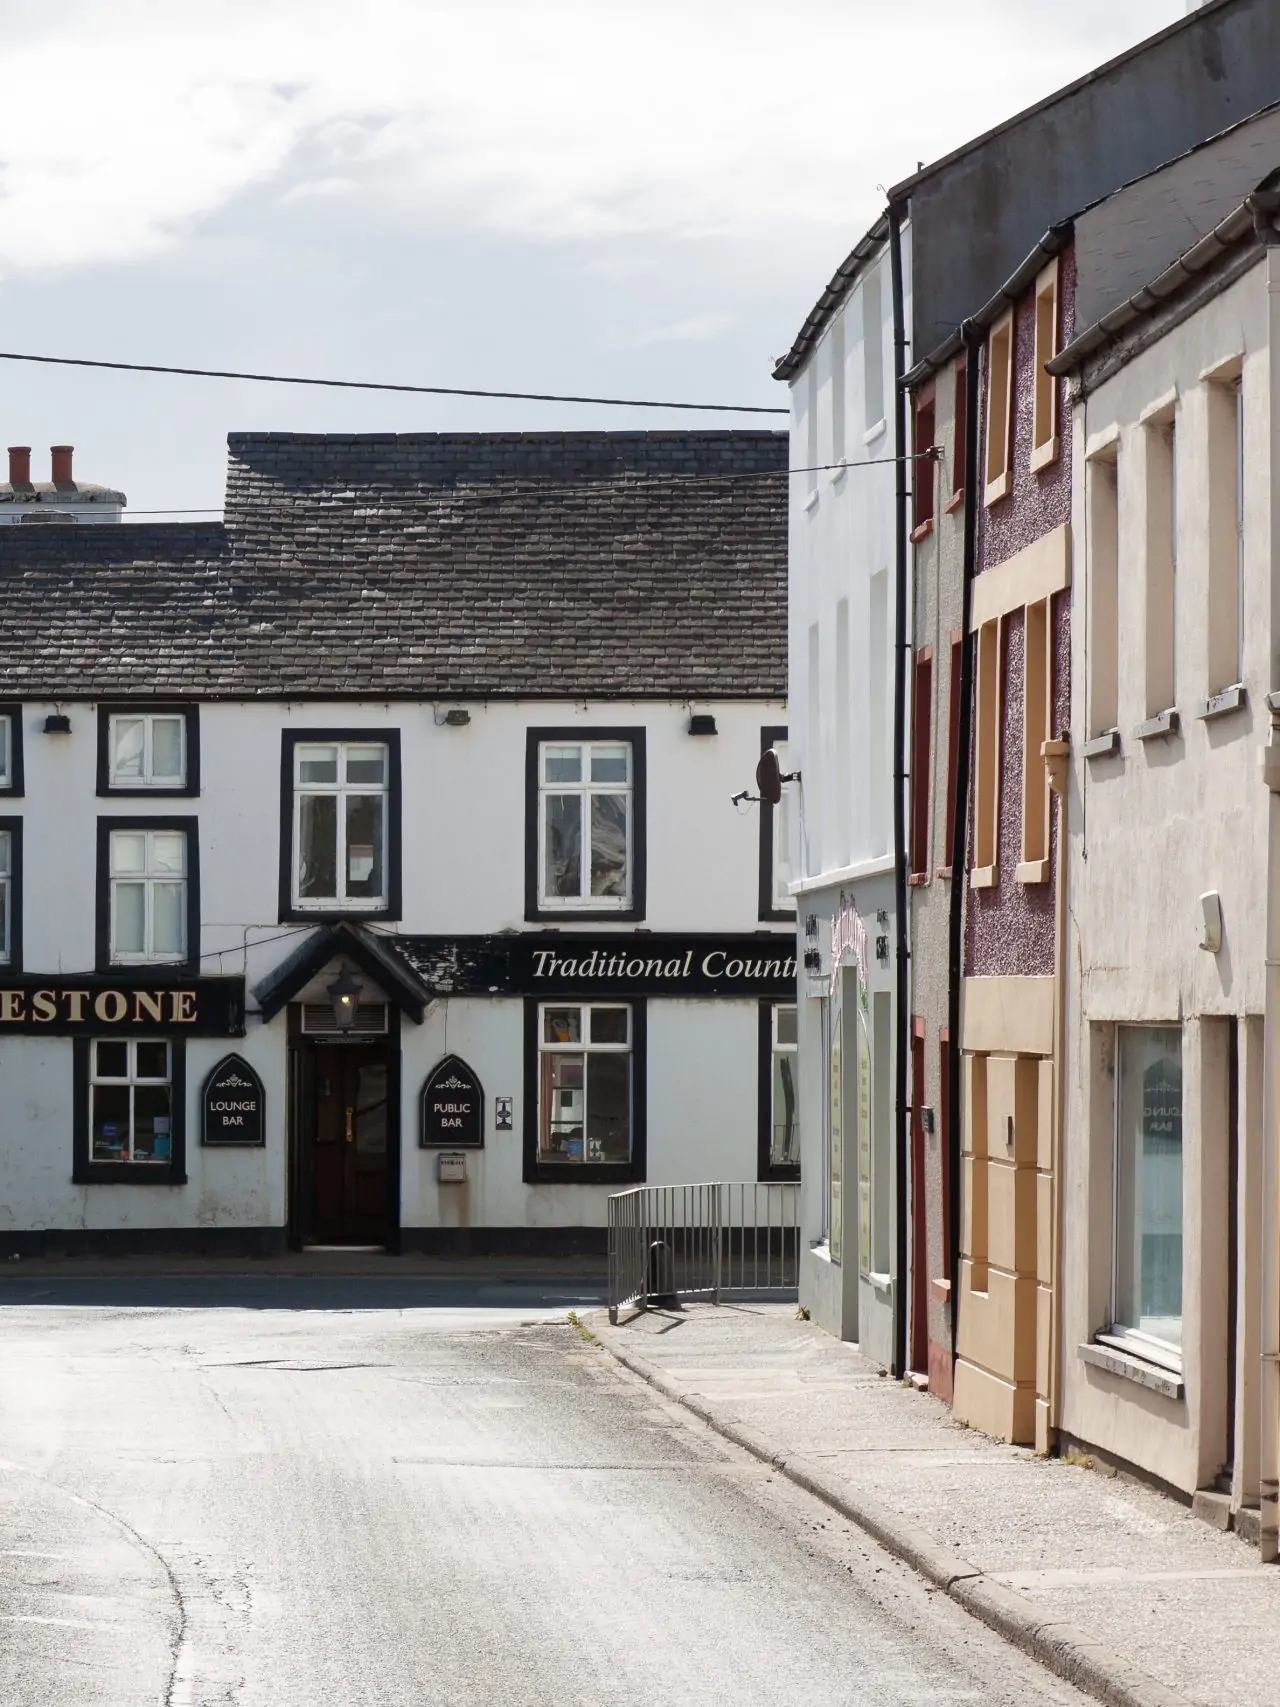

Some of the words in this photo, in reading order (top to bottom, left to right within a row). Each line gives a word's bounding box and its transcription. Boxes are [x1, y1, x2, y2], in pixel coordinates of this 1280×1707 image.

[531, 950, 694, 977] Traditional
[701, 951, 798, 978] Countr
[210, 1101, 257, 1111] LOUNGE
[433, 1103, 471, 1113] PUBLIC
[222, 1116, 244, 1126] BAR
[441, 1118, 463, 1127] BAR
